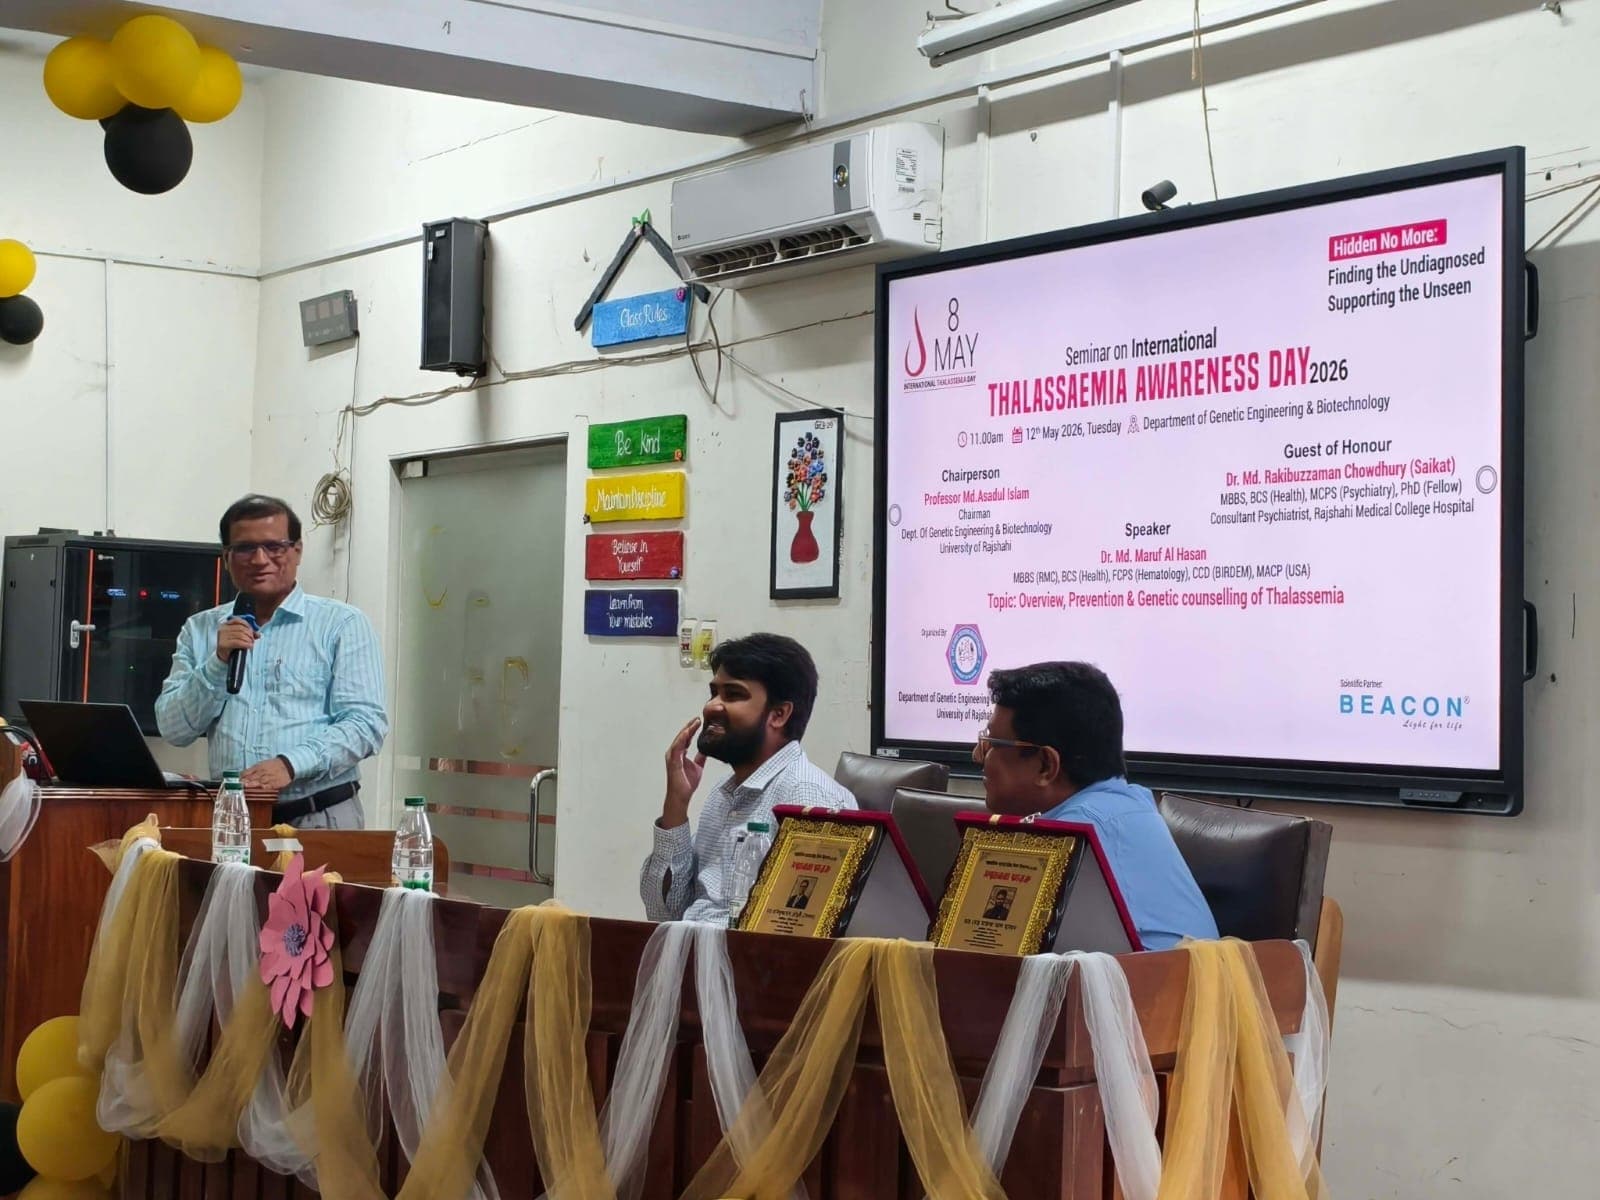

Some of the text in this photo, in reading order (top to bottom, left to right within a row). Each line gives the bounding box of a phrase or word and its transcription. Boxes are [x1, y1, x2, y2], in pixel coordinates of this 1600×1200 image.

[1334, 227, 1438, 257] Hidden No More:
[1328, 246, 1485, 286] Finding the Undiagnosed
[1328, 280, 1471, 314] Supporting the Unseen
[620, 305, 668, 329] Class Rules
[948, 298, 959, 332] 8
[934, 332, 979, 372] MAY
[1066, 326, 1217, 366] Seminar on International
[988, 368, 1127, 416] THALASSAEMIA
[1136, 352, 1259, 401] AWARENESS
[1269, 346, 1310, 388] DAY
[970, 432, 1004, 445] 11.00am
[1042, 426, 1058, 441] May
[1061, 424, 1084, 438] 2026,
[1087, 419, 1121, 436] Tuesday
[1144, 411, 1194, 430] Department
[1198, 410, 1207, 424] of
[1210, 406, 1244, 423] Genetic
[1247, 402, 1303, 422] Engineering
[1306, 400, 1314, 413] &
[1317, 394, 1390, 414] Biotechnology
[614, 428, 660, 456] Be Kind
[1284, 439, 1392, 459] Guest of Honour
[942, 468, 1000, 484] Chairperson
[1226, 456, 1456, 486] Dr. Md. Rakibuzzaman Chowdhury (Saikat)
[594, 488, 632, 512] Maintain
[924, 492, 960, 506] Professor
[1008, 488, 1029, 500] Islam
[1220, 479, 1462, 506] MBBS, BCS (Health), MCPS (Psychiatry), PhD (Fellow)
[958, 508, 990, 521] Chairman
[1210, 498, 1474, 525] Consultant Psychiatrist, Rajshahi Medical College Hospital
[902, 528, 918, 540] Dept.
[929, 526, 953, 538] Genetic
[955, 524, 994, 538] Engineering
[995, 524, 1000, 535] &
[1002, 522, 1052, 536] Biotechnology
[1125, 522, 1171, 539] Speaker
[612, 539, 648, 555] Believe in
[940, 540, 1012, 556] University of Rajshahi
[1101, 548, 1206, 563] Dr. Md. Maruf Al Hasan
[617, 556, 644, 573] Yourself
[1014, 564, 1310, 584] MBBS (RMC), BCS (Health), FCPS (Hematology), CCD (BIRDEM), MACP (USA)
[610, 595, 628, 610] Learn
[988, 586, 1344, 611] Topic: Overview, Prevention & Genetic counselling of Thalassemia
[607, 612, 653, 628] Your mistakes
[899, 692, 990, 706] Department of Genetic Engineering
[937, 710, 963, 721] University
[965, 710, 970, 719] of
[1430, 720, 1442, 730] for
